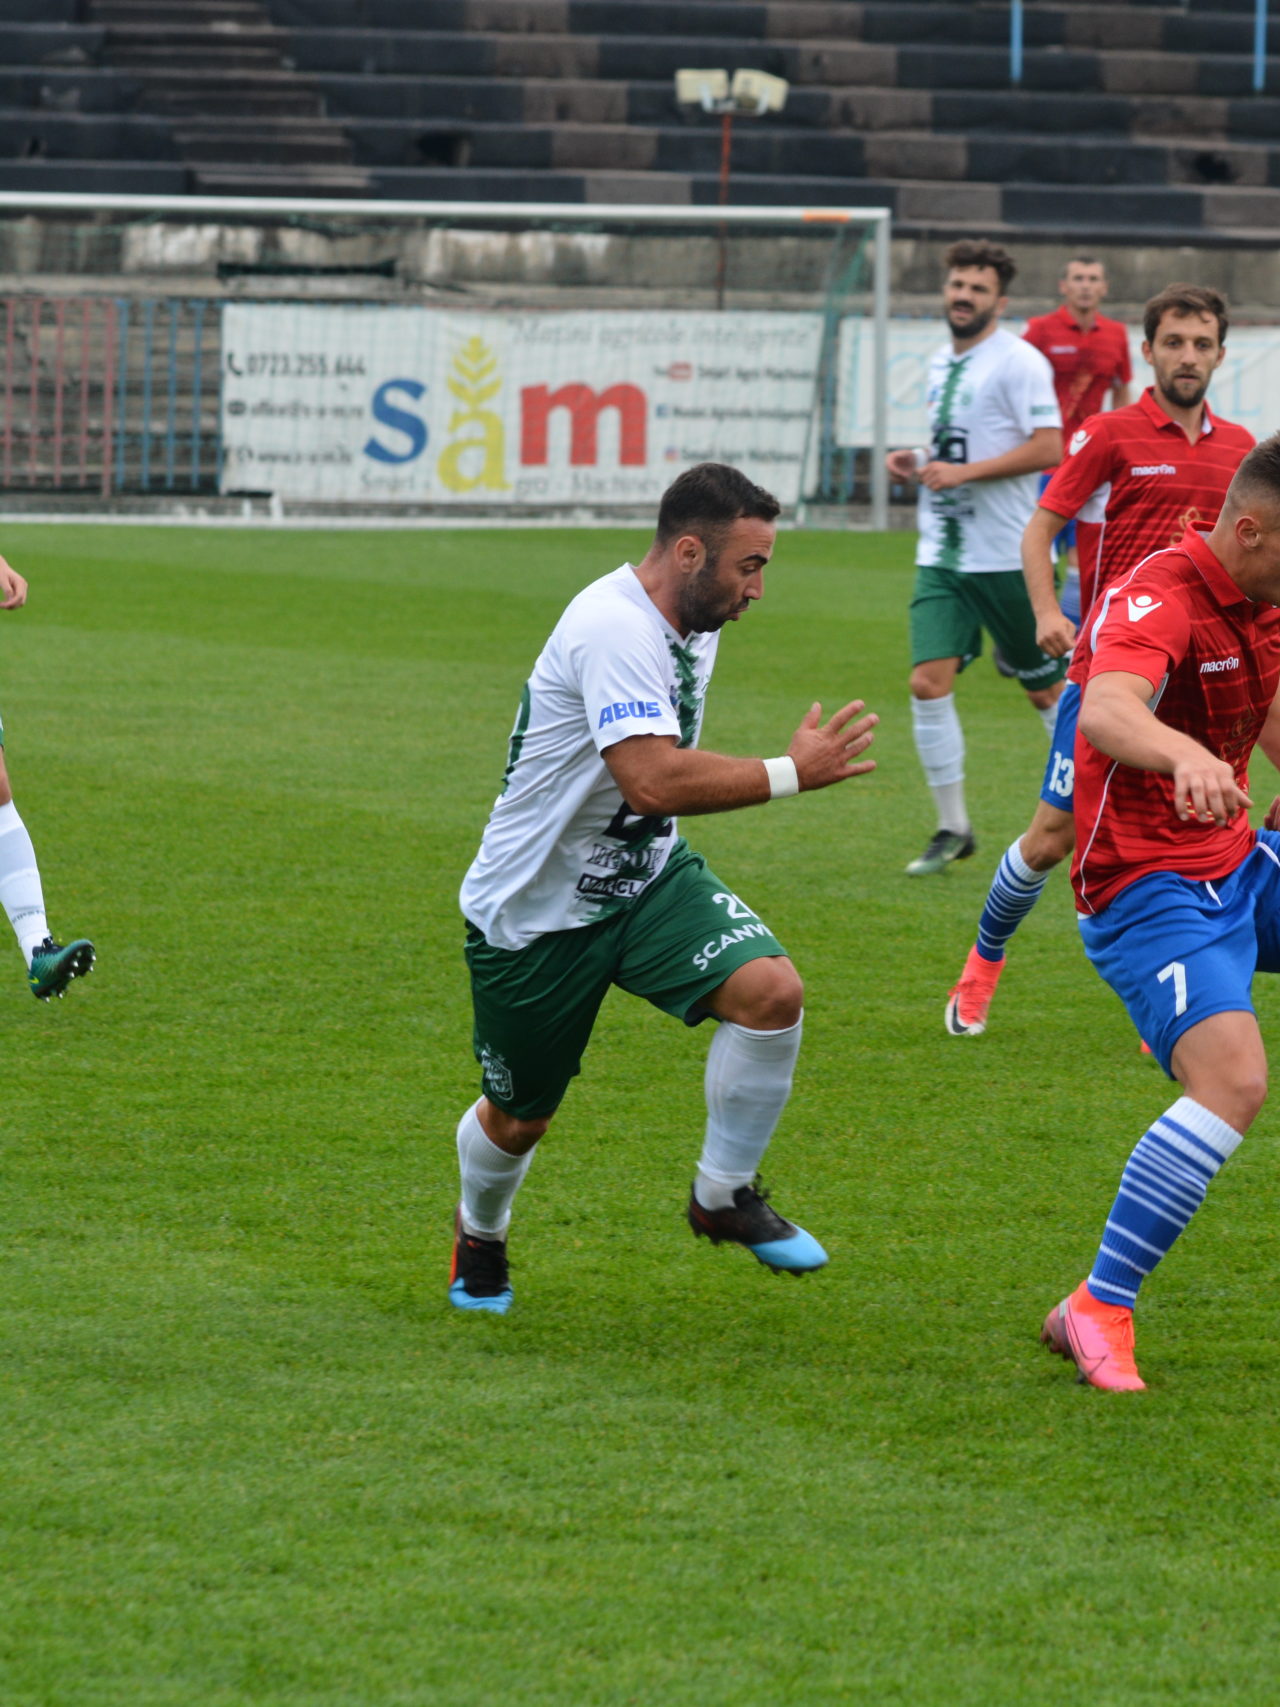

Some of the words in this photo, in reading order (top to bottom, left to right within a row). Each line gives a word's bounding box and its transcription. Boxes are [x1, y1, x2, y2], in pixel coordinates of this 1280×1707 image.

[1131, 464, 1176, 476] macron
[1200, 656, 1240, 674] macron
[598, 700, 662, 729] ABUS
[1048, 750, 1075, 797] 13
[711, 892, 761, 920] 2
[1156, 961, 1188, 1017] 7
